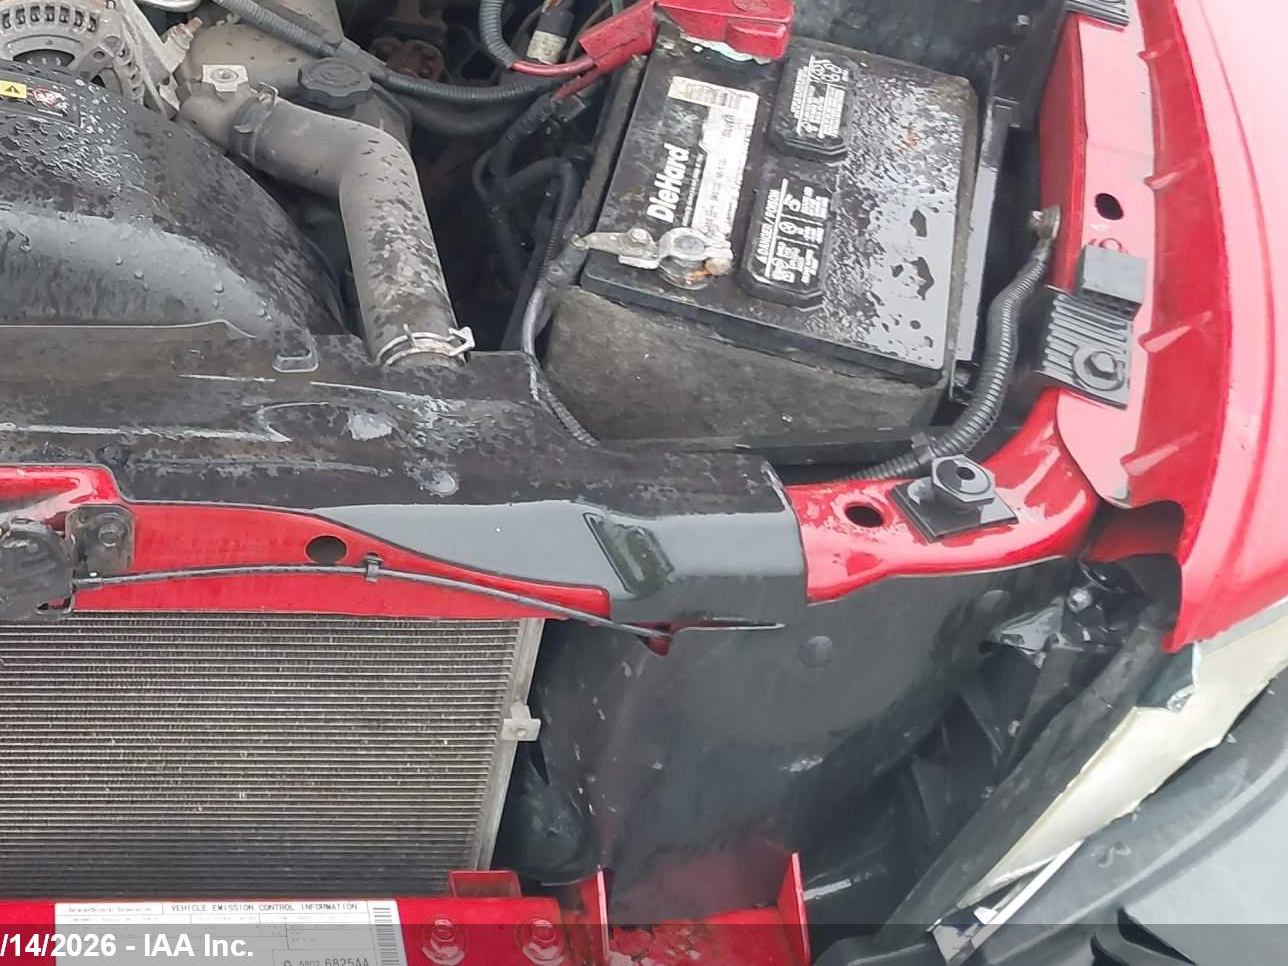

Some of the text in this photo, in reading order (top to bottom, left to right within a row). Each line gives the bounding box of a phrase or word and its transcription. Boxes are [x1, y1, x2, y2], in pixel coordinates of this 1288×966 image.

[647, 142, 689, 223] DieHard
[171, 903, 358, 912] VEHICLE EMISSION CONTROL INFORMATION
